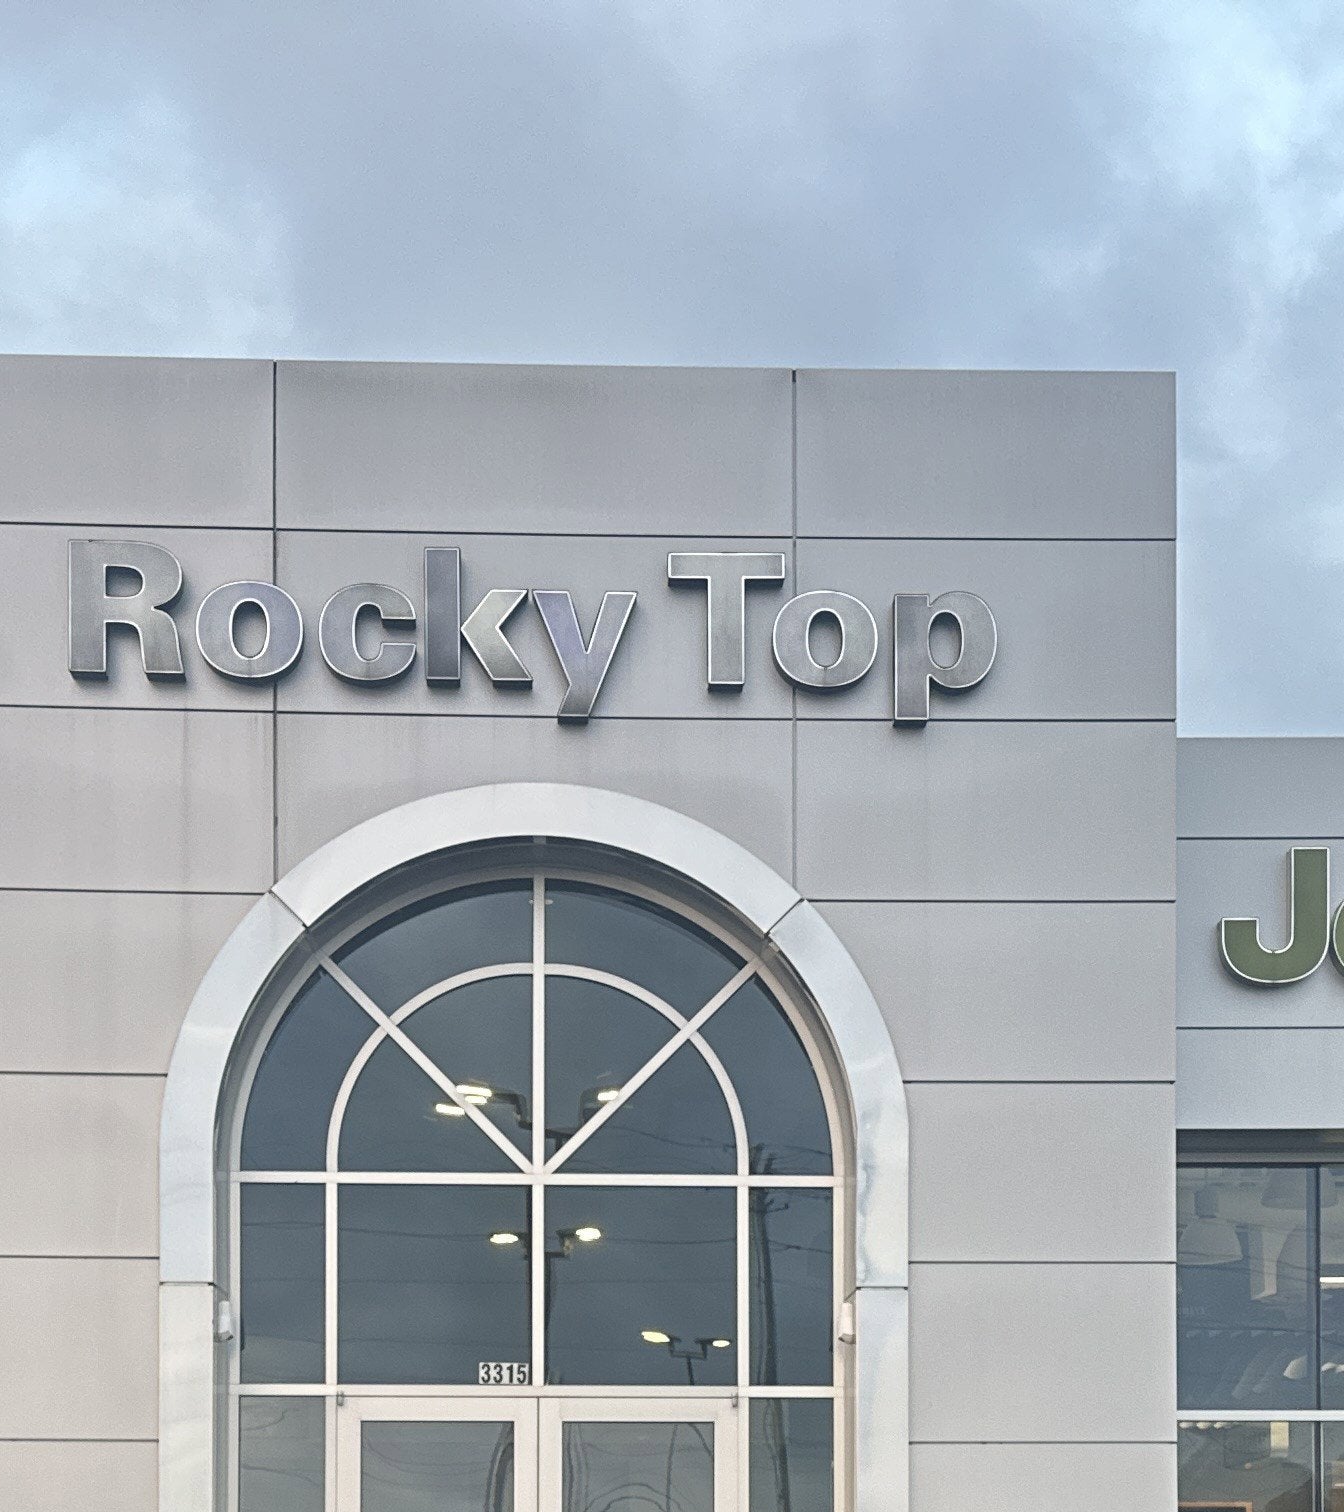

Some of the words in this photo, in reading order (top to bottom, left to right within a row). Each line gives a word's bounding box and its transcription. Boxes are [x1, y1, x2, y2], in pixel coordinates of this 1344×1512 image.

[67, 539, 639, 723] Rocky
[666, 551, 999, 726] Top
[481, 1363, 527, 1384] 3315
